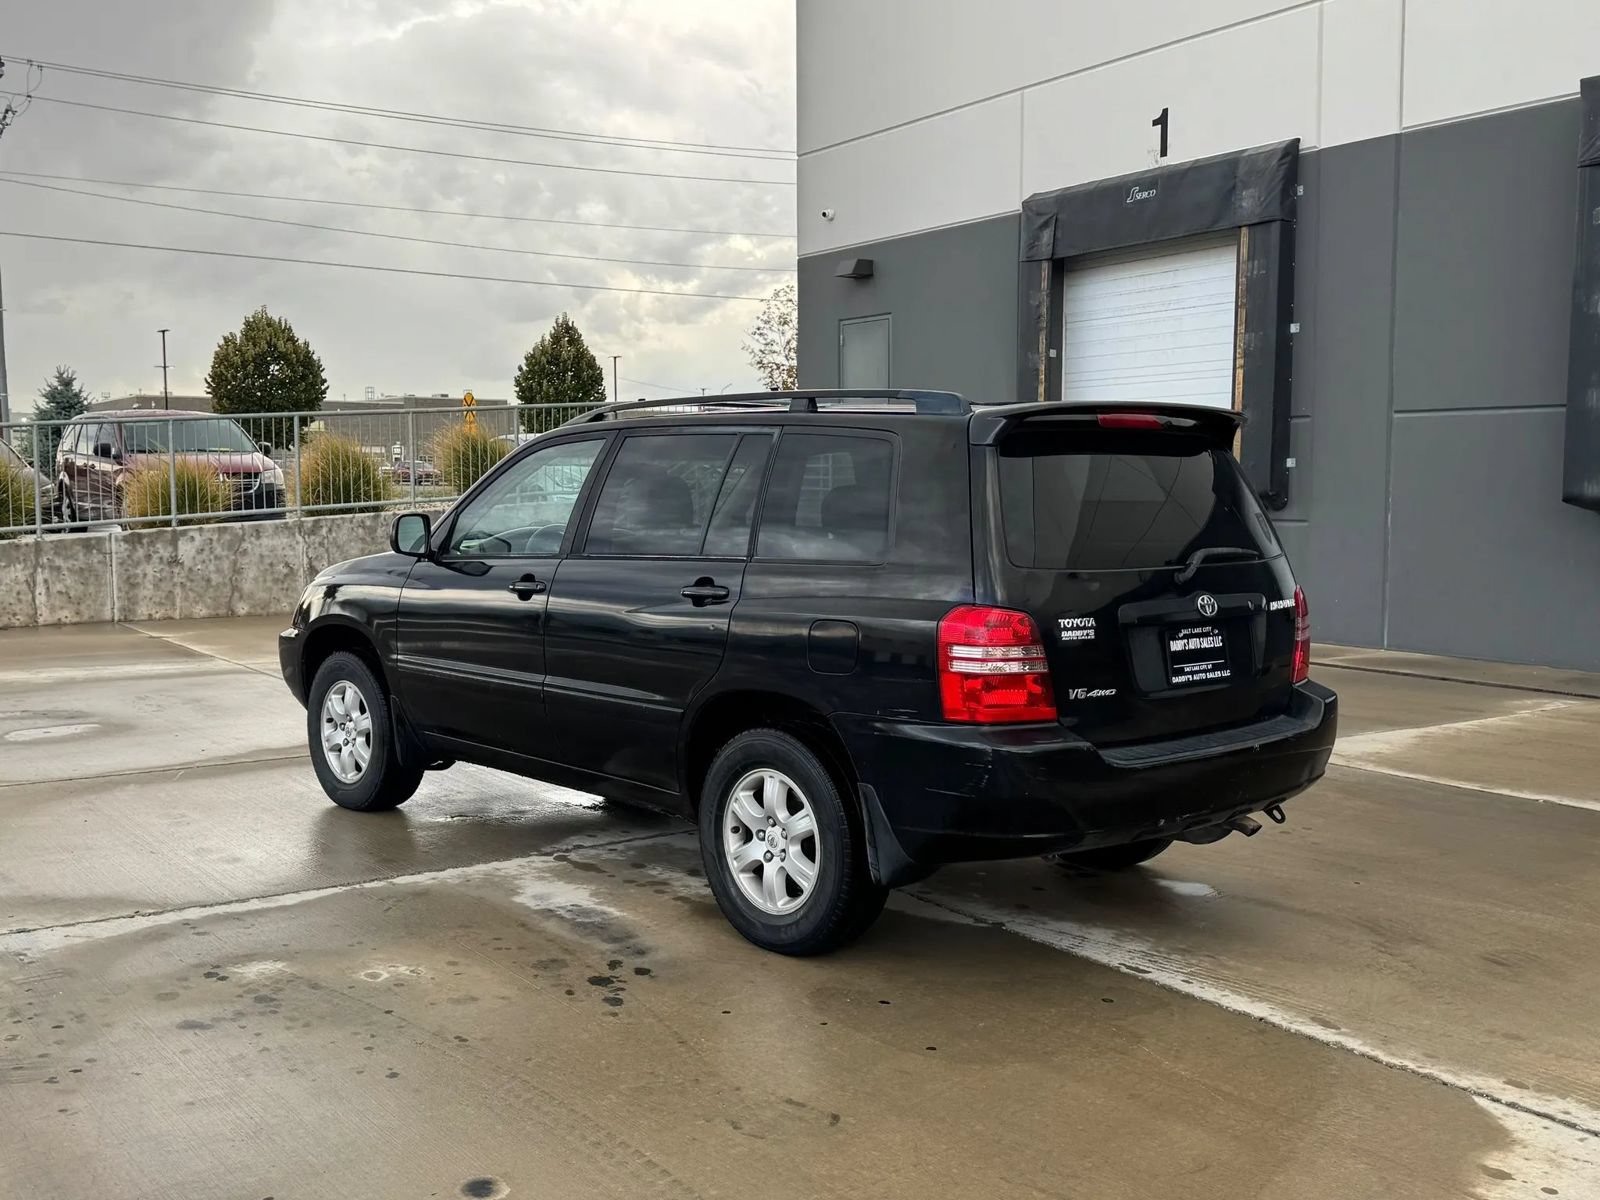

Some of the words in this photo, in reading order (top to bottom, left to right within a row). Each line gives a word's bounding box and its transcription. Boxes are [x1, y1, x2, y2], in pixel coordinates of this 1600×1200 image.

[1151, 107, 1169, 158] 1
[1058, 617, 1096, 628] TOYOTA
[1170, 639, 1188, 651] DADDY'S
[1188, 638, 1200, 649] AUTO
[1200, 636, 1214, 648] SALES
[1214, 636, 1222, 647] LLC
[1172, 675, 1192, 683] DADDY'S
[1068, 687, 1087, 700] V6
